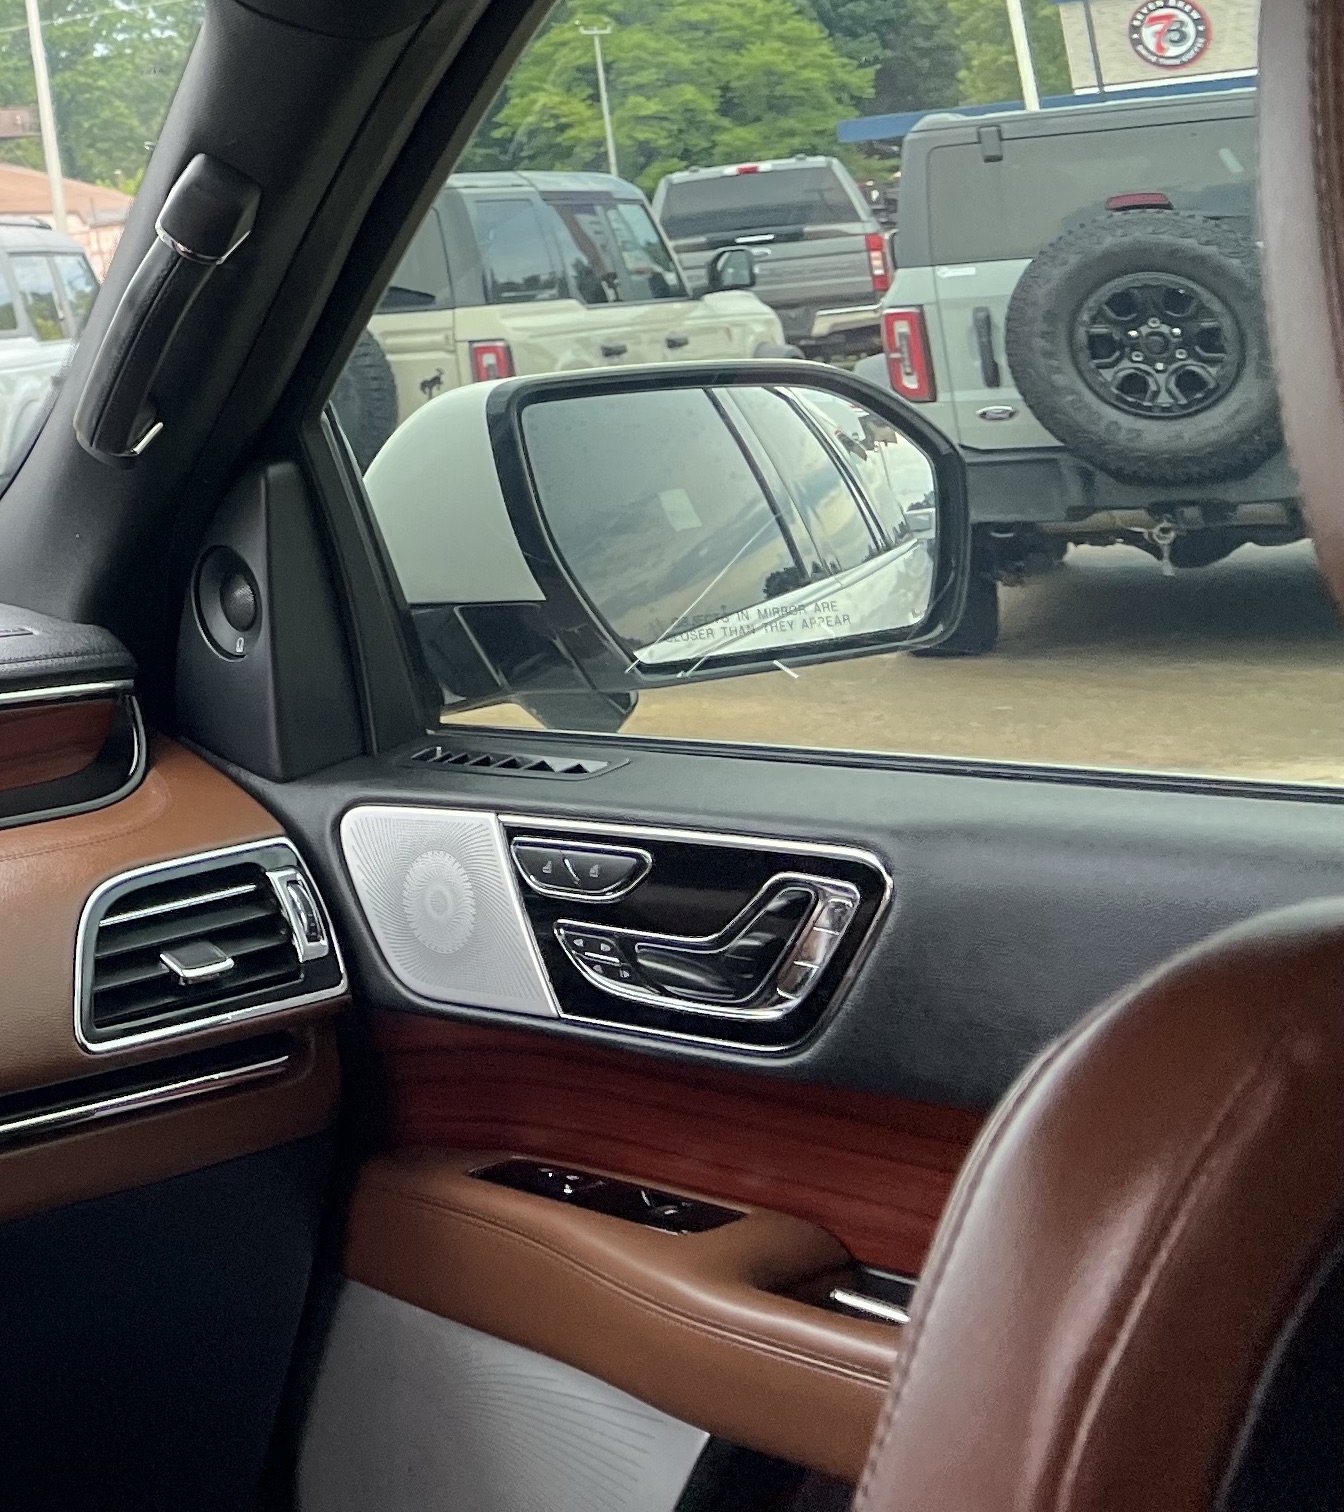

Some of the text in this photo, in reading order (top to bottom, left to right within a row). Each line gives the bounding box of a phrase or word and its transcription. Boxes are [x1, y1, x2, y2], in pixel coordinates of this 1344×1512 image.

[737, 609, 750, 621] IN
[757, 604, 808, 620] MIRROR
[814, 600, 839, 613] ARE
[720, 623, 756, 638] THAN
[763, 619, 794, 633] THEY
[801, 614, 852, 630] APPEAR
